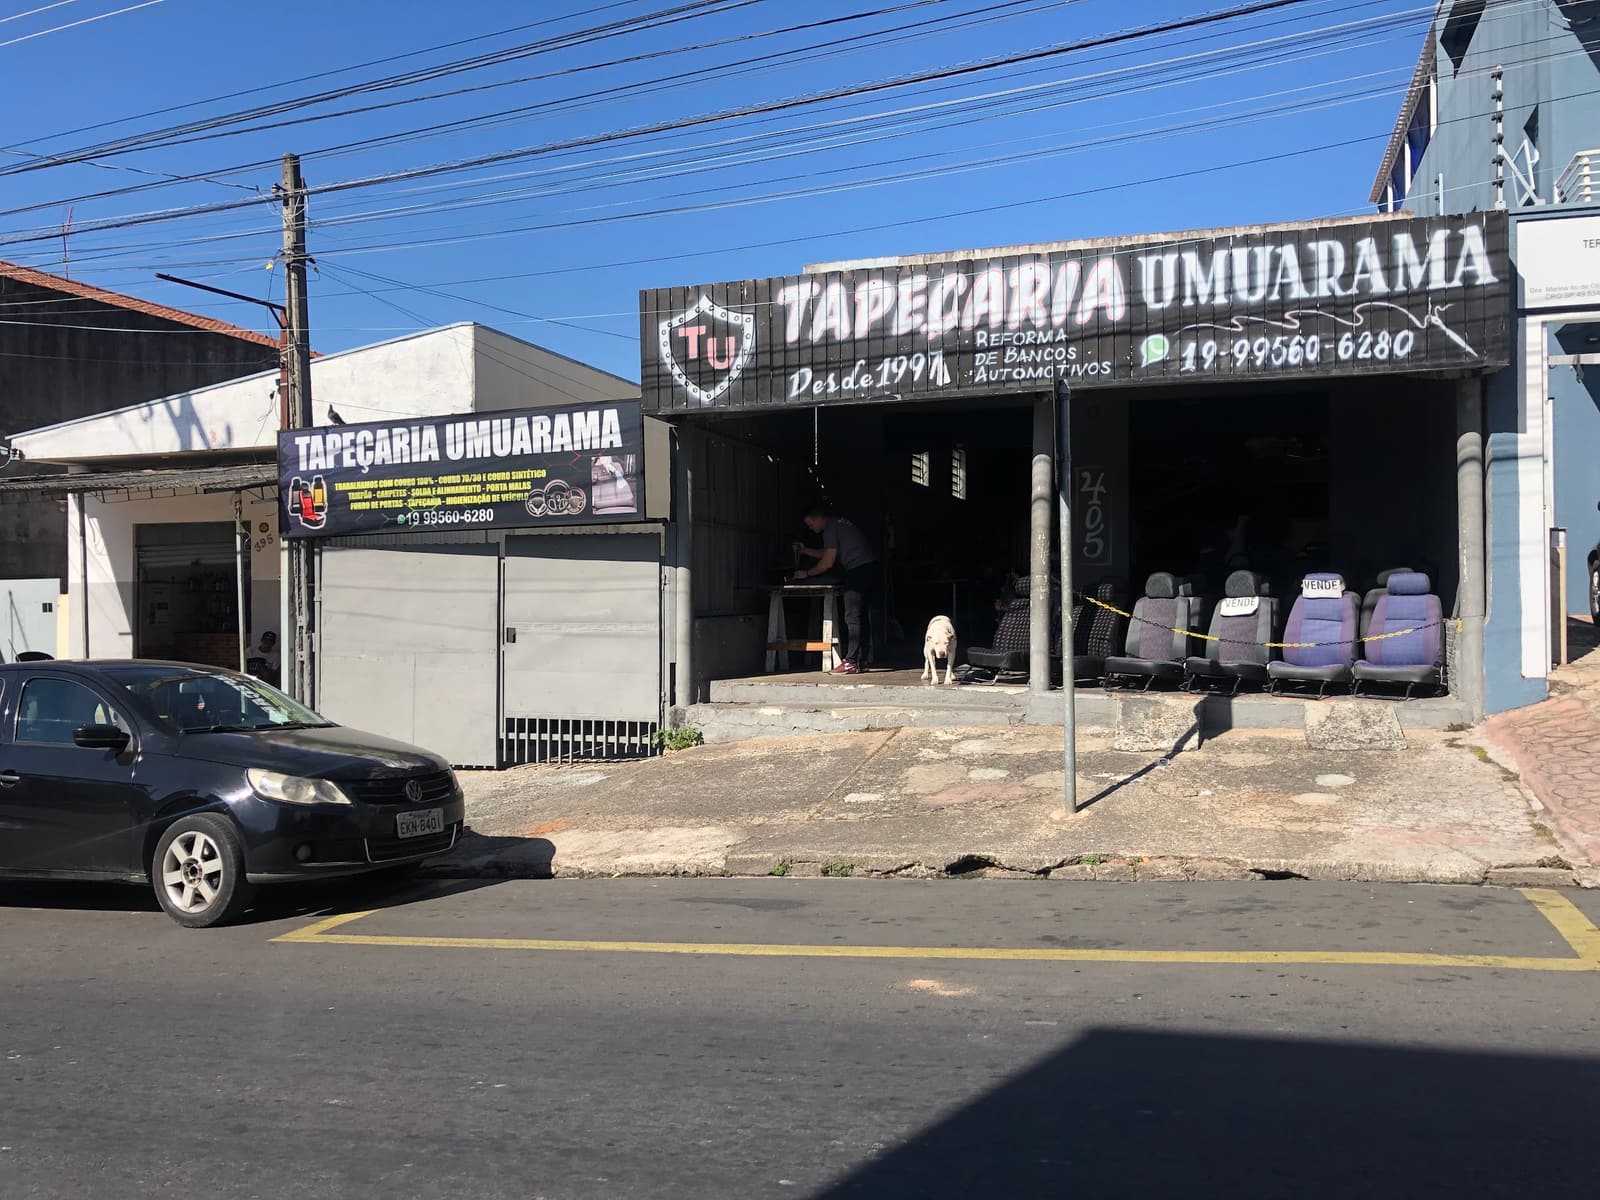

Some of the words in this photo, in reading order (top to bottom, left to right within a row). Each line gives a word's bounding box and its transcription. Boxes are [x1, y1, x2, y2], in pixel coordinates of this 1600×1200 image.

[777, 258, 1126, 342] TAPEÇARIA
[1138, 225, 1499, 309] UMUARAMA
[678, 325, 736, 370] TU
[976, 328, 1068, 347] REFORMA
[974, 351, 998, 366] DE
[1004, 346, 1077, 363] BANCOS
[1180, 329, 1414, 373] 19-99560-6280
[789, 359, 874, 398] Desde
[974, 361, 1112, 382] AUTOMOTIVOS
[295, 424, 441, 473] TAPEÇARIA
[445, 409, 623, 461] UMUARAMA
[334, 480, 378, 491] TRABALHAMOS
[378, 479, 393, 488] COM
[394, 478, 416, 486] COURO
[416, 476, 434, 485] 100%
[438, 475, 460, 484] COURO
[482, 474, 486, 482] E
[487, 472, 510, 480] COURO
[512, 469, 546, 479] SINTÉTICO
[376, 489, 407, 498] CARPETES
[486, 483, 507, 492] PORTA
[508, 482, 532, 490] MALAS
[370, 501, 378, 509] DE
[380, 500, 403, 508] PORTAS
[446, 494, 490, 504] HIGIENIZAÇÃO
[492, 494, 500, 502] DE
[406, 512, 420, 525] 19
[423, 508, 494, 525] 99560-6280
[254, 534, 274, 553] 395
[1304, 580, 1337, 590] VENDE
[1226, 598, 1256, 608] VENDE
